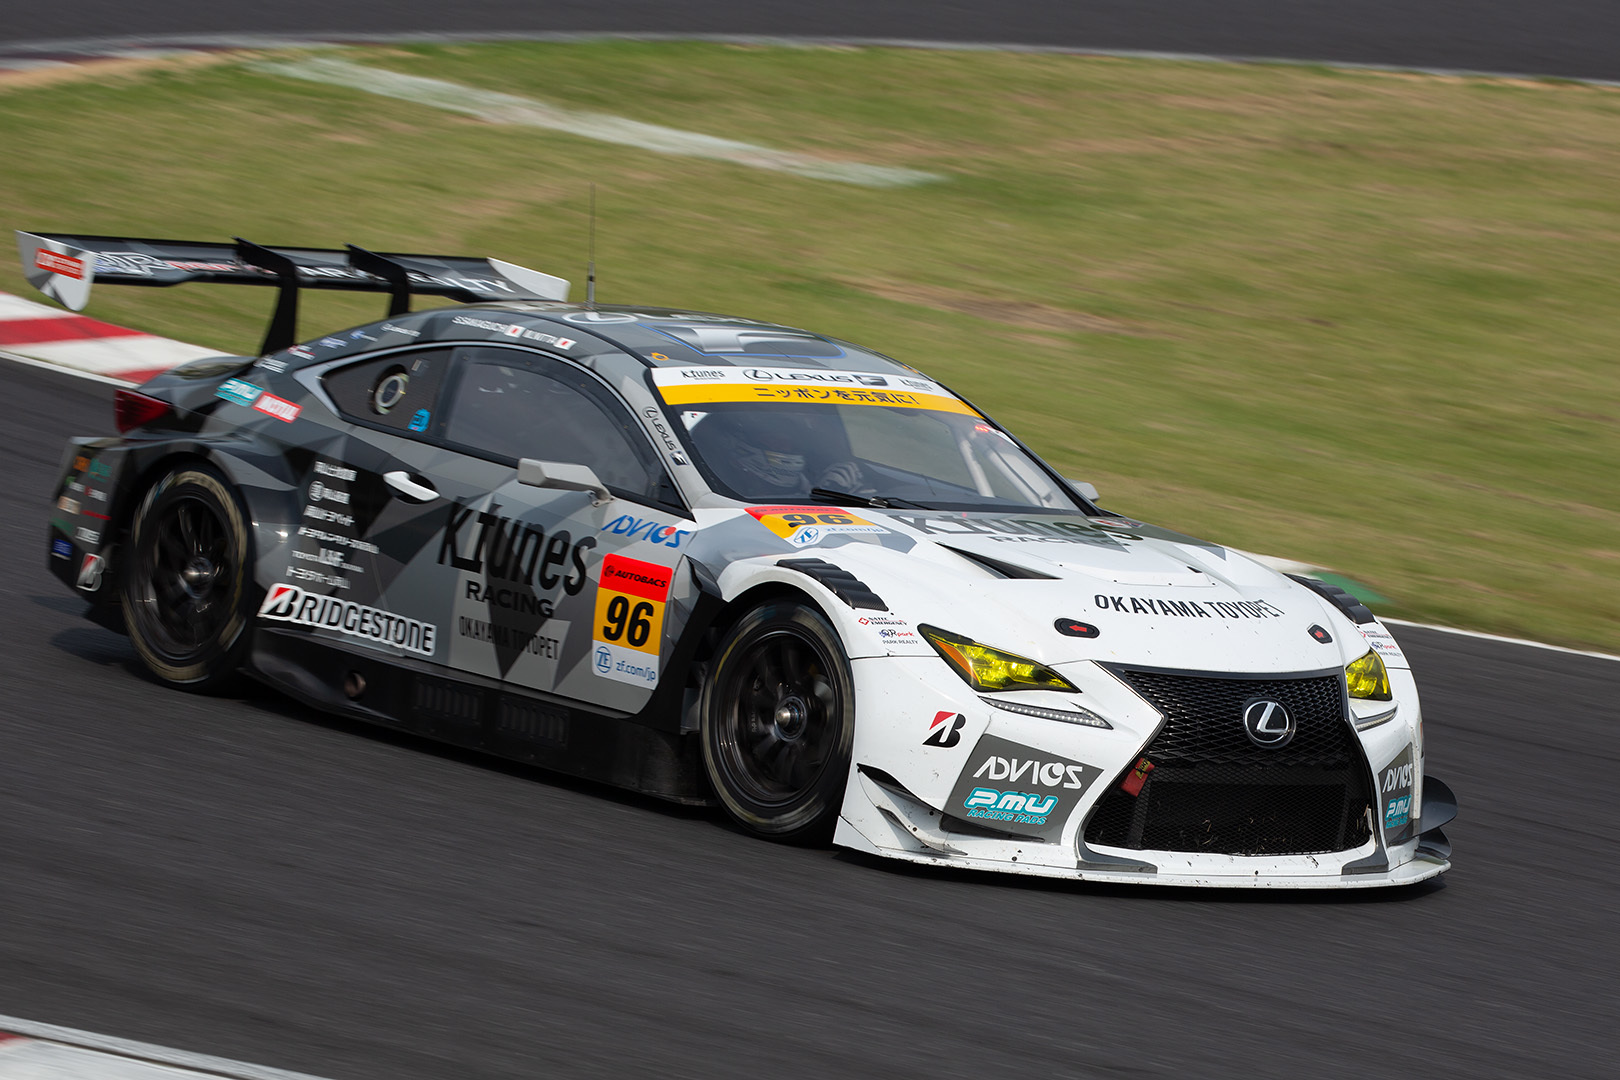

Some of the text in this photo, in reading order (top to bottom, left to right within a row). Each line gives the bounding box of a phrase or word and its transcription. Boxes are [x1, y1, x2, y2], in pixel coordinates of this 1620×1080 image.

[775, 373, 853, 383] LEXUS
[652, 418, 677, 450] LEXUS
[601, 514, 690, 548] ADVICS
[782, 514, 853, 528] 96
[615, 569, 667, 588] AUTOBACS
[466, 580, 554, 619] RACING
[1094, 594, 1285, 619] OKAYAMA TOYOPET
[261, 587, 434, 654] BRIDGESTONE
[603, 595, 654, 647] 96
[616, 660, 656, 682] zf.com/jp
[972, 755, 1083, 790] ADVICS
[967, 809, 1048, 826] RACING PADS
